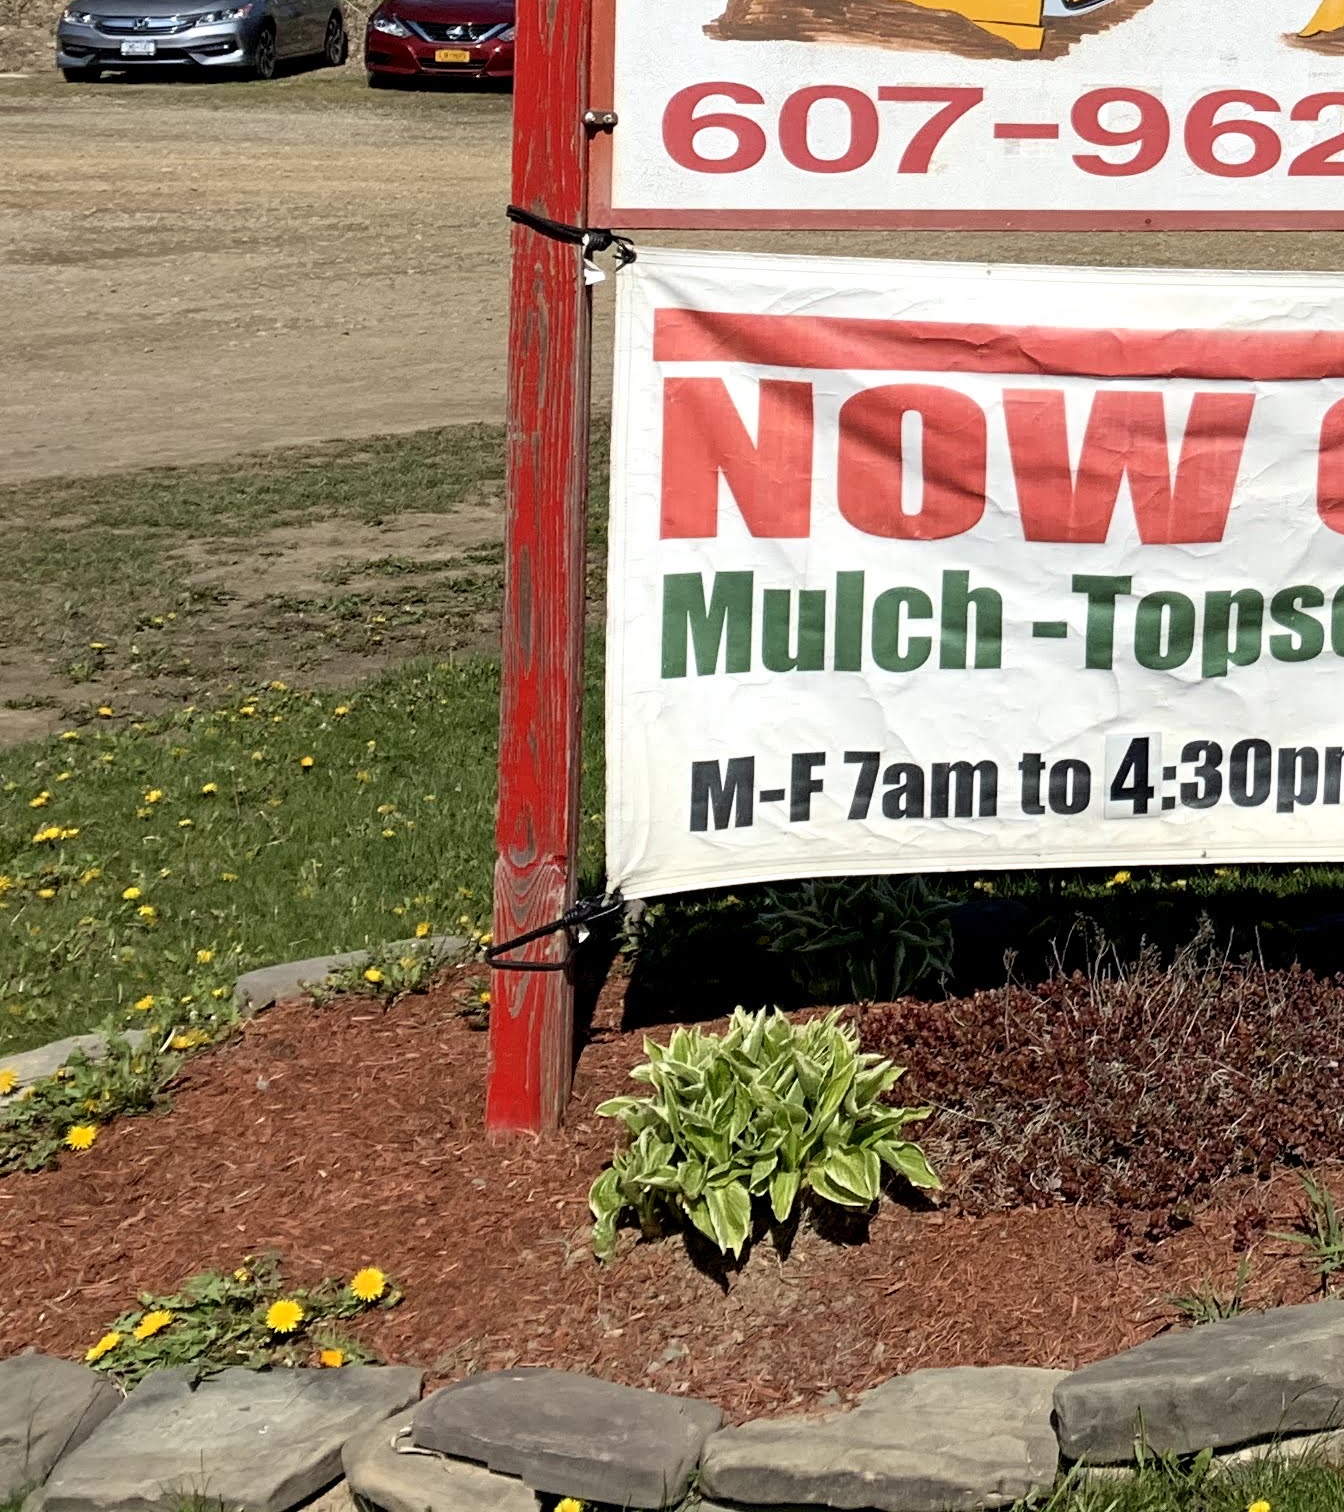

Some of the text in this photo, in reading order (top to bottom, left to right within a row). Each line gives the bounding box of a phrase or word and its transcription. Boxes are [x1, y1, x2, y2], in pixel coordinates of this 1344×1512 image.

[658, 375, 1254, 545] NOW
[659, 568, 1004, 680] Mulch
[687, 749, 826, 832] M-F
[843, 748, 998, 822] 7am
[1017, 751, 1093, 816] to
